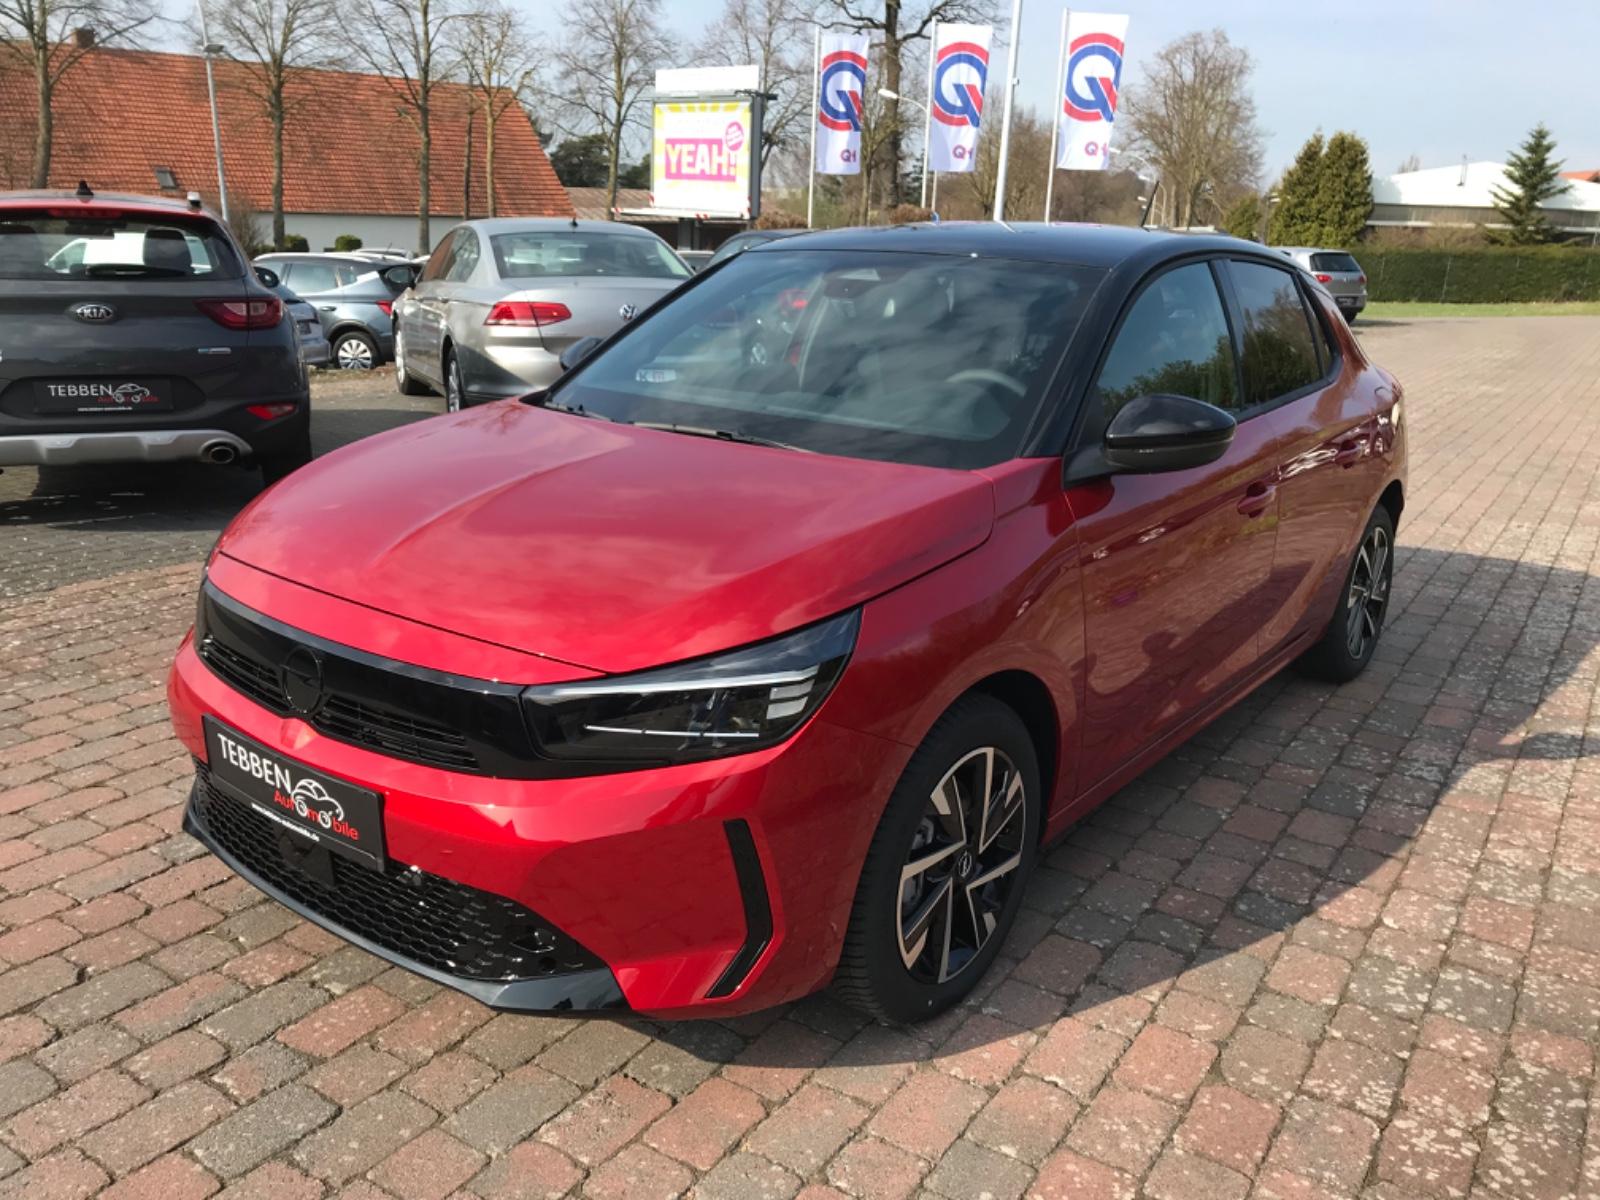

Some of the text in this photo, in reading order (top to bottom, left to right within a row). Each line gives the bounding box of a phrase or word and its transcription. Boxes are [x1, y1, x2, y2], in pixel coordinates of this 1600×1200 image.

[666, 143, 736, 176] YEAH!
[83, 308, 110, 318] KIA
[47, 384, 114, 396] TEBBEN
[217, 733, 291, 793] TEBBEN
